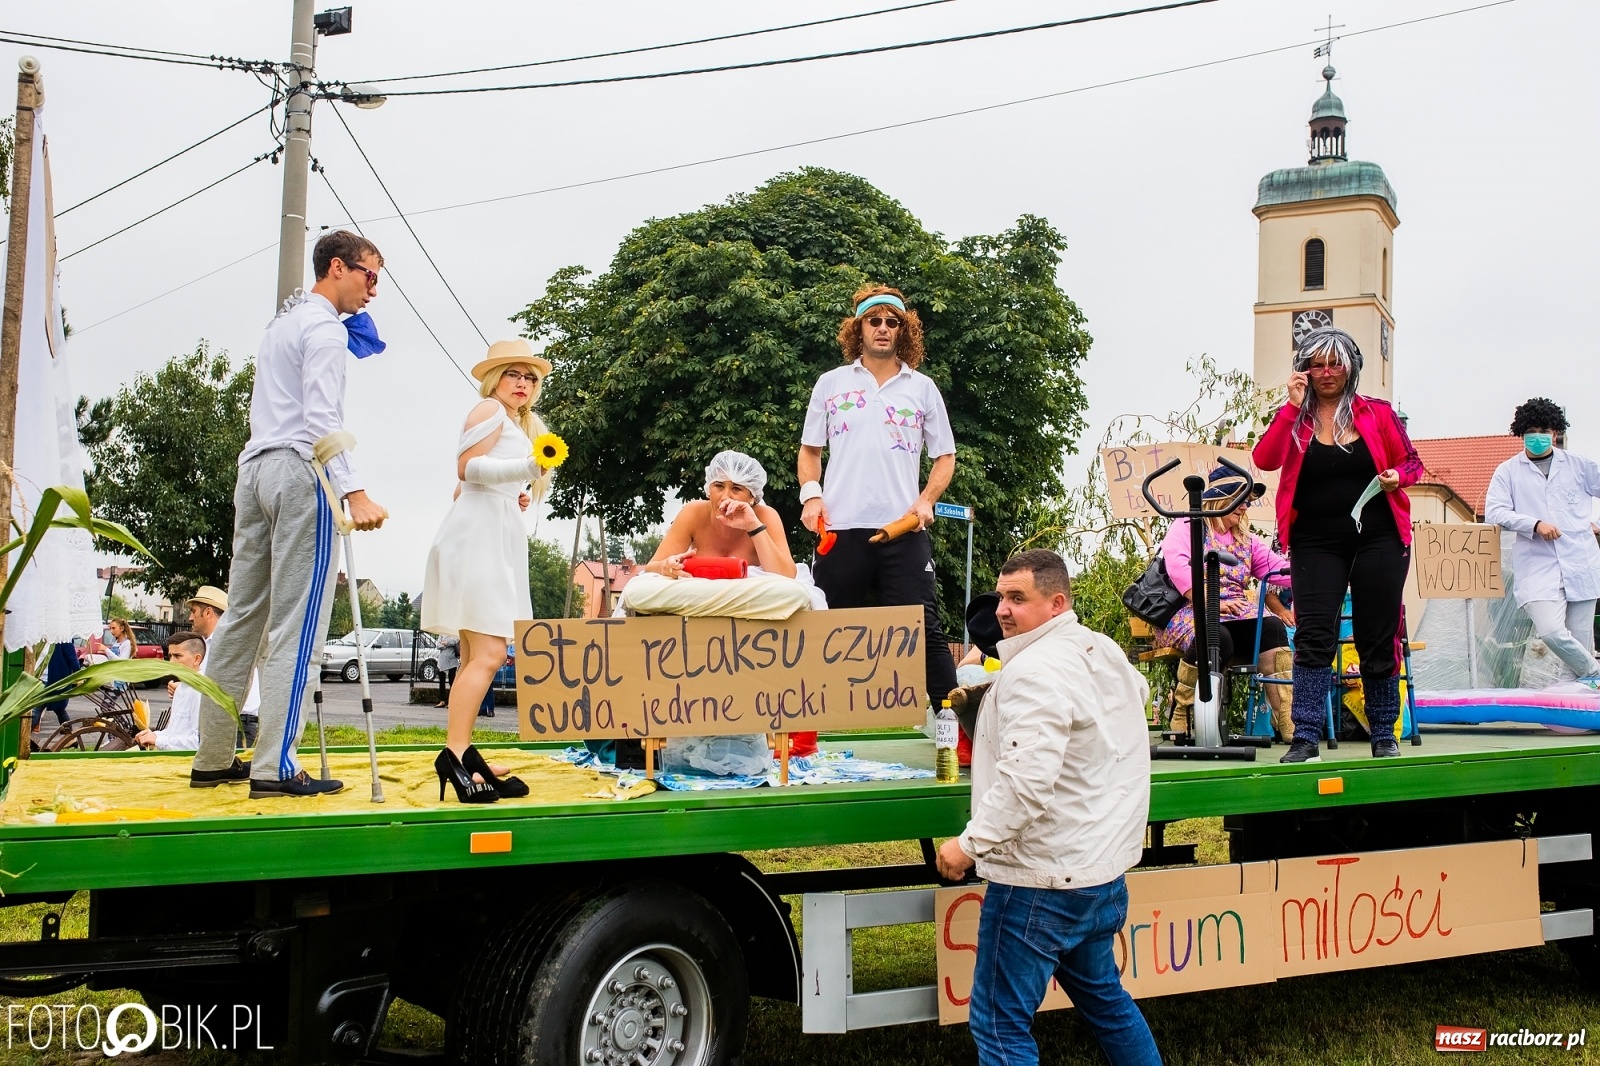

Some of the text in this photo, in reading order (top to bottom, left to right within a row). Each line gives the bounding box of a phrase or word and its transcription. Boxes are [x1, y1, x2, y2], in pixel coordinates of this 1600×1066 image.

[944, 506, 964, 516] Szkolna
[1423, 558, 1499, 592] WODNE
[641, 617, 806, 681] relaksu
[822, 620, 922, 684] czyni
[755, 678, 827, 729] cycki
[848, 682, 856, 713] i
[865, 670, 918, 711] uda
